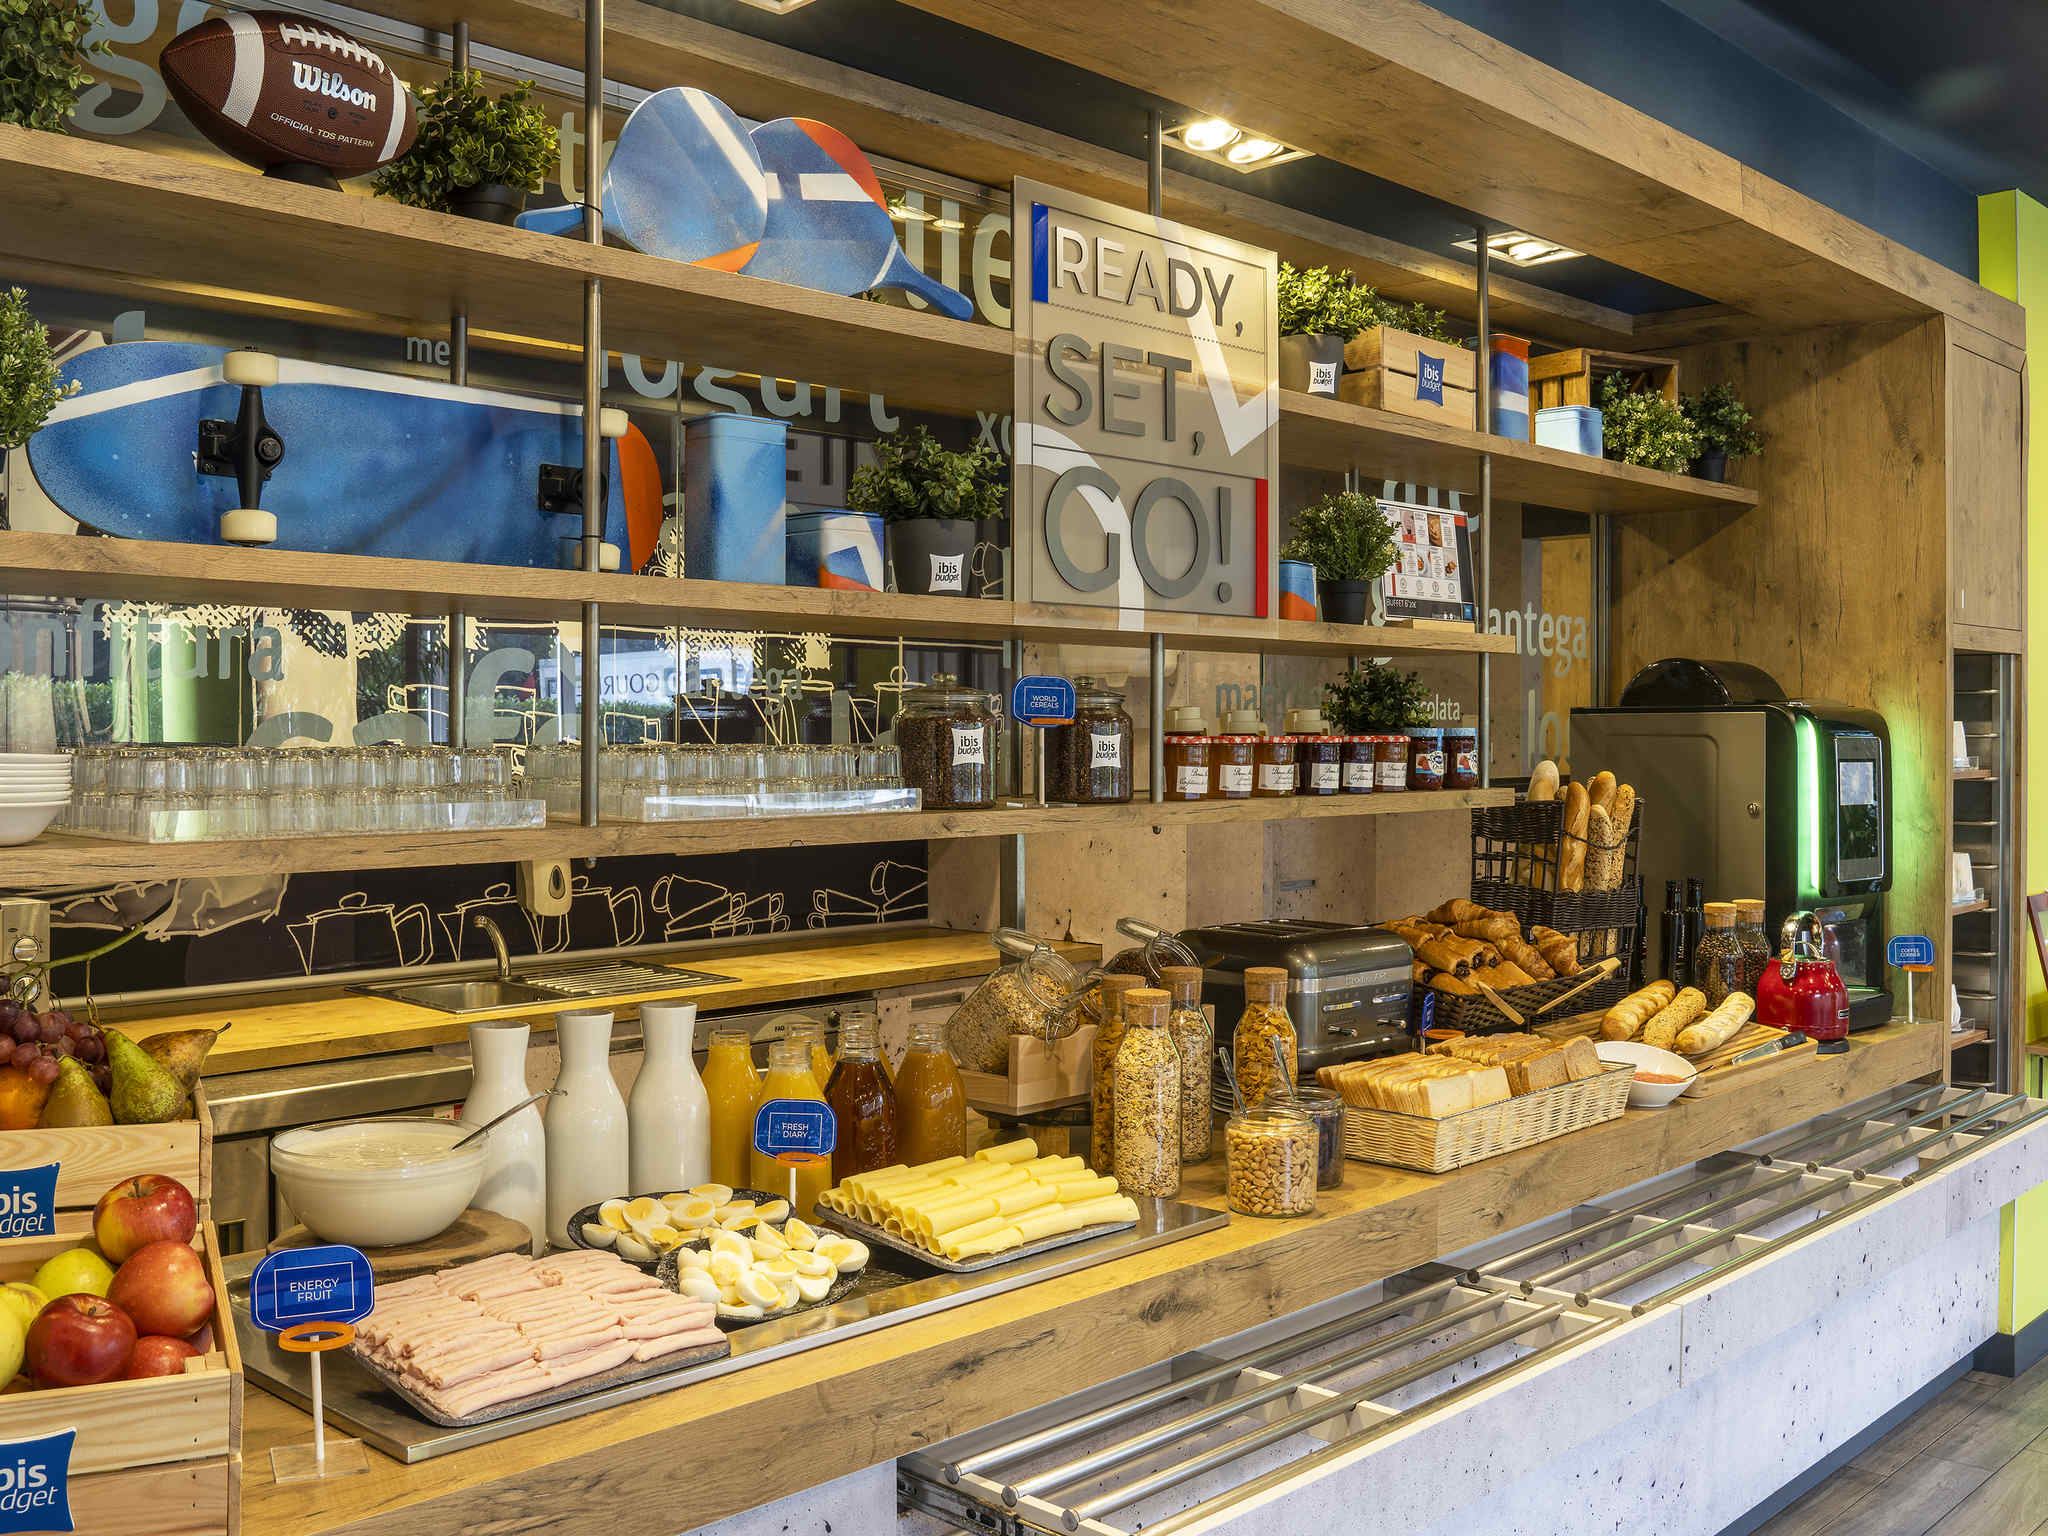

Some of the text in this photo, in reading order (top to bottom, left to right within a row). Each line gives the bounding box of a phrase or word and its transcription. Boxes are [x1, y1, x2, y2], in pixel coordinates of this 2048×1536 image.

[292, 60, 377, 112] Wilson
[270, 112, 315, 134] OFFICIAL
[318, 128, 337, 140] TDS
[337, 134, 375, 147] PATTERN
[1055, 225, 1244, 338] READY,
[1316, 368, 1332, 379] ibis
[1424, 362, 1439, 381] ibis
[1313, 377, 1333, 386] budget
[1421, 378, 1441, 393] budget
[1044, 333, 1206, 457] SET,
[1044, 465, 1233, 605] GO!
[938, 562, 957, 574] ibis
[935, 573, 960, 583] budget
[0, 598, 285, 682] nfitura
[1488, 601, 1587, 678] antega
[1030, 701, 1060, 709] CEREALS
[960, 735, 979, 747] ibis
[1098, 741, 1116, 752] ibis
[957, 746, 981, 756] budget
[1095, 750, 1118, 760] budget
[782, 1122, 809, 1131] FRESH
[782, 1130, 809, 1138] DIARY
[0, 1185, 38, 1214] is
[0, 1213, 47, 1238] dget
[289, 1277, 340, 1293] ENERGY
[297, 1288, 333, 1303] FRUIT
[0, 1458, 48, 1490] bis
[0, 1484, 59, 1515] dget
